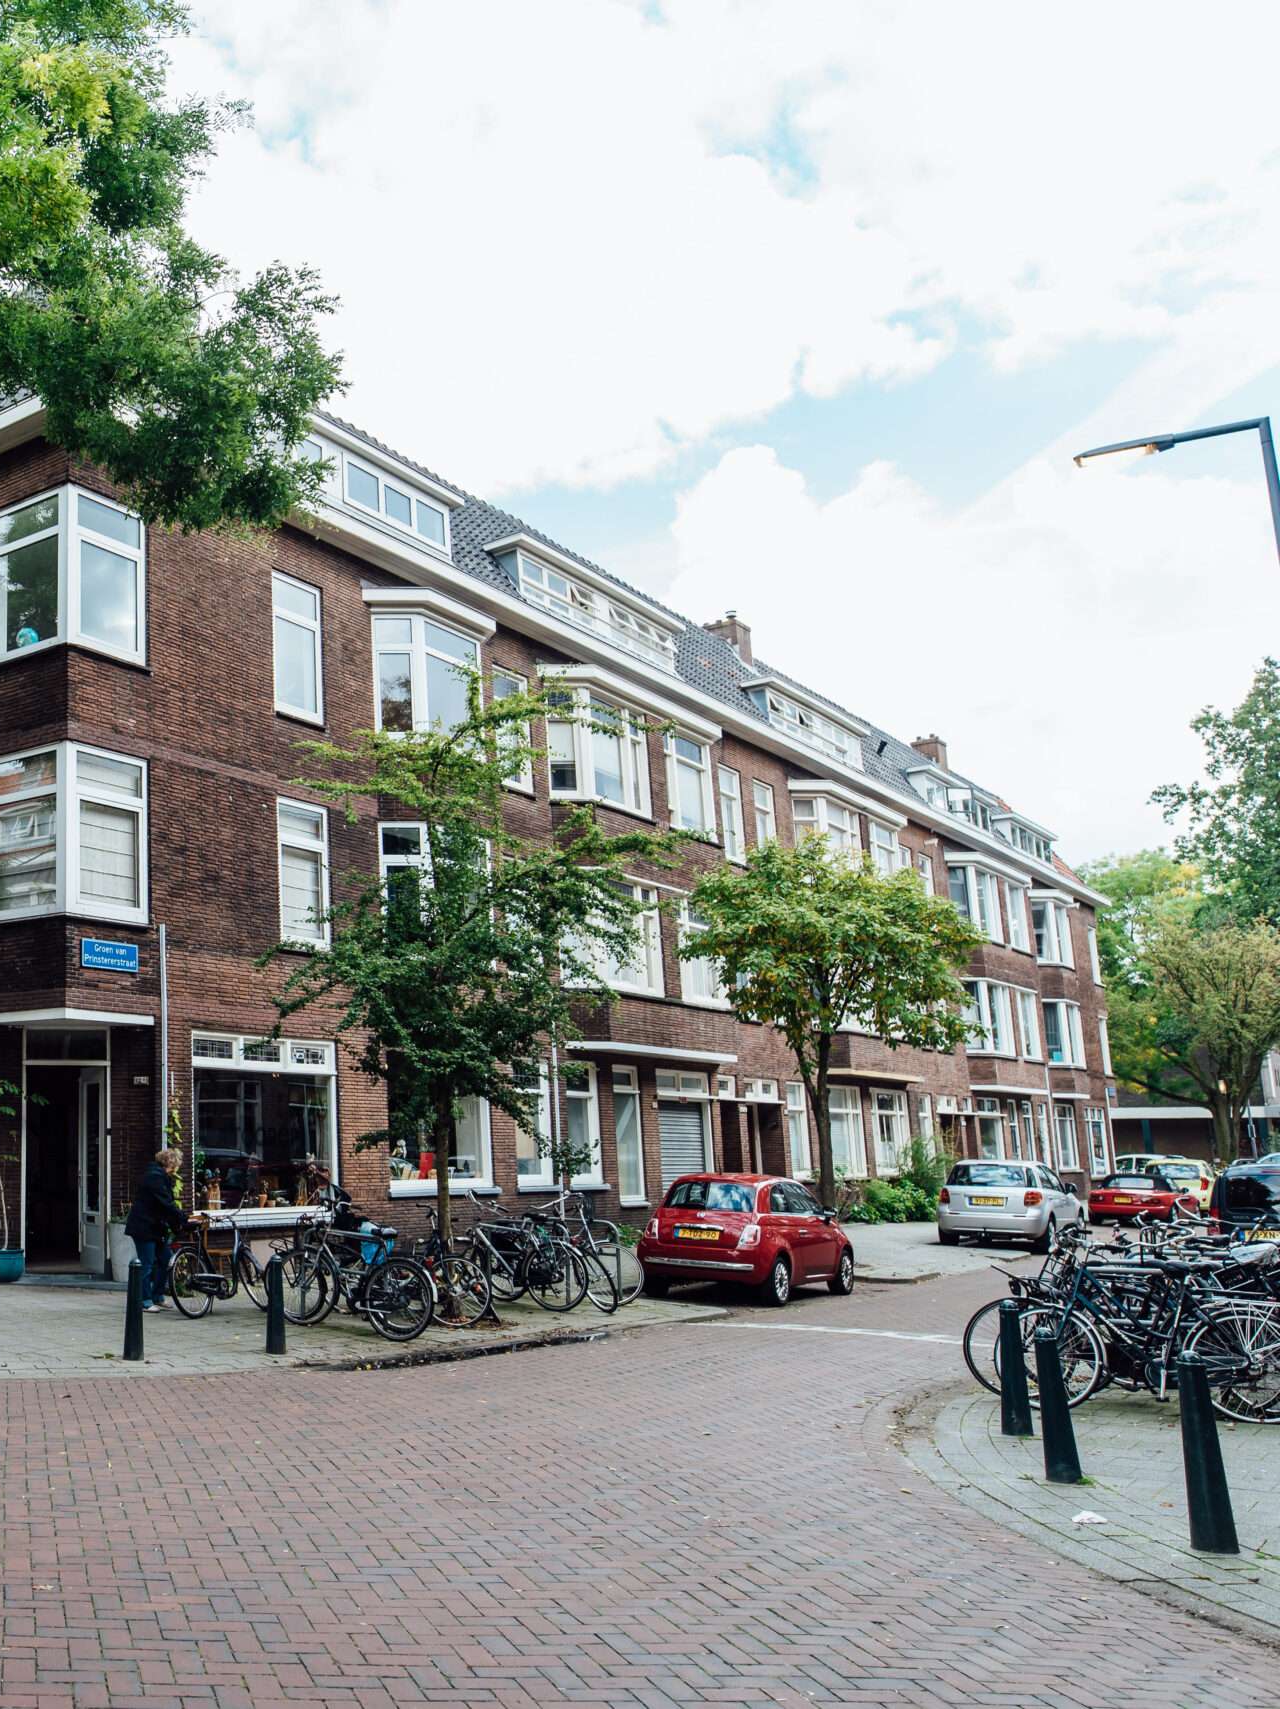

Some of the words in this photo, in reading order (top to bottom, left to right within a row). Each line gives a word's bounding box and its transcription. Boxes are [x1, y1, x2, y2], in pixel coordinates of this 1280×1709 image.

[94, 943, 113, 954] Groen
[115, 948, 127, 956] van
[84, 953, 136, 968] Prinstererstraat
